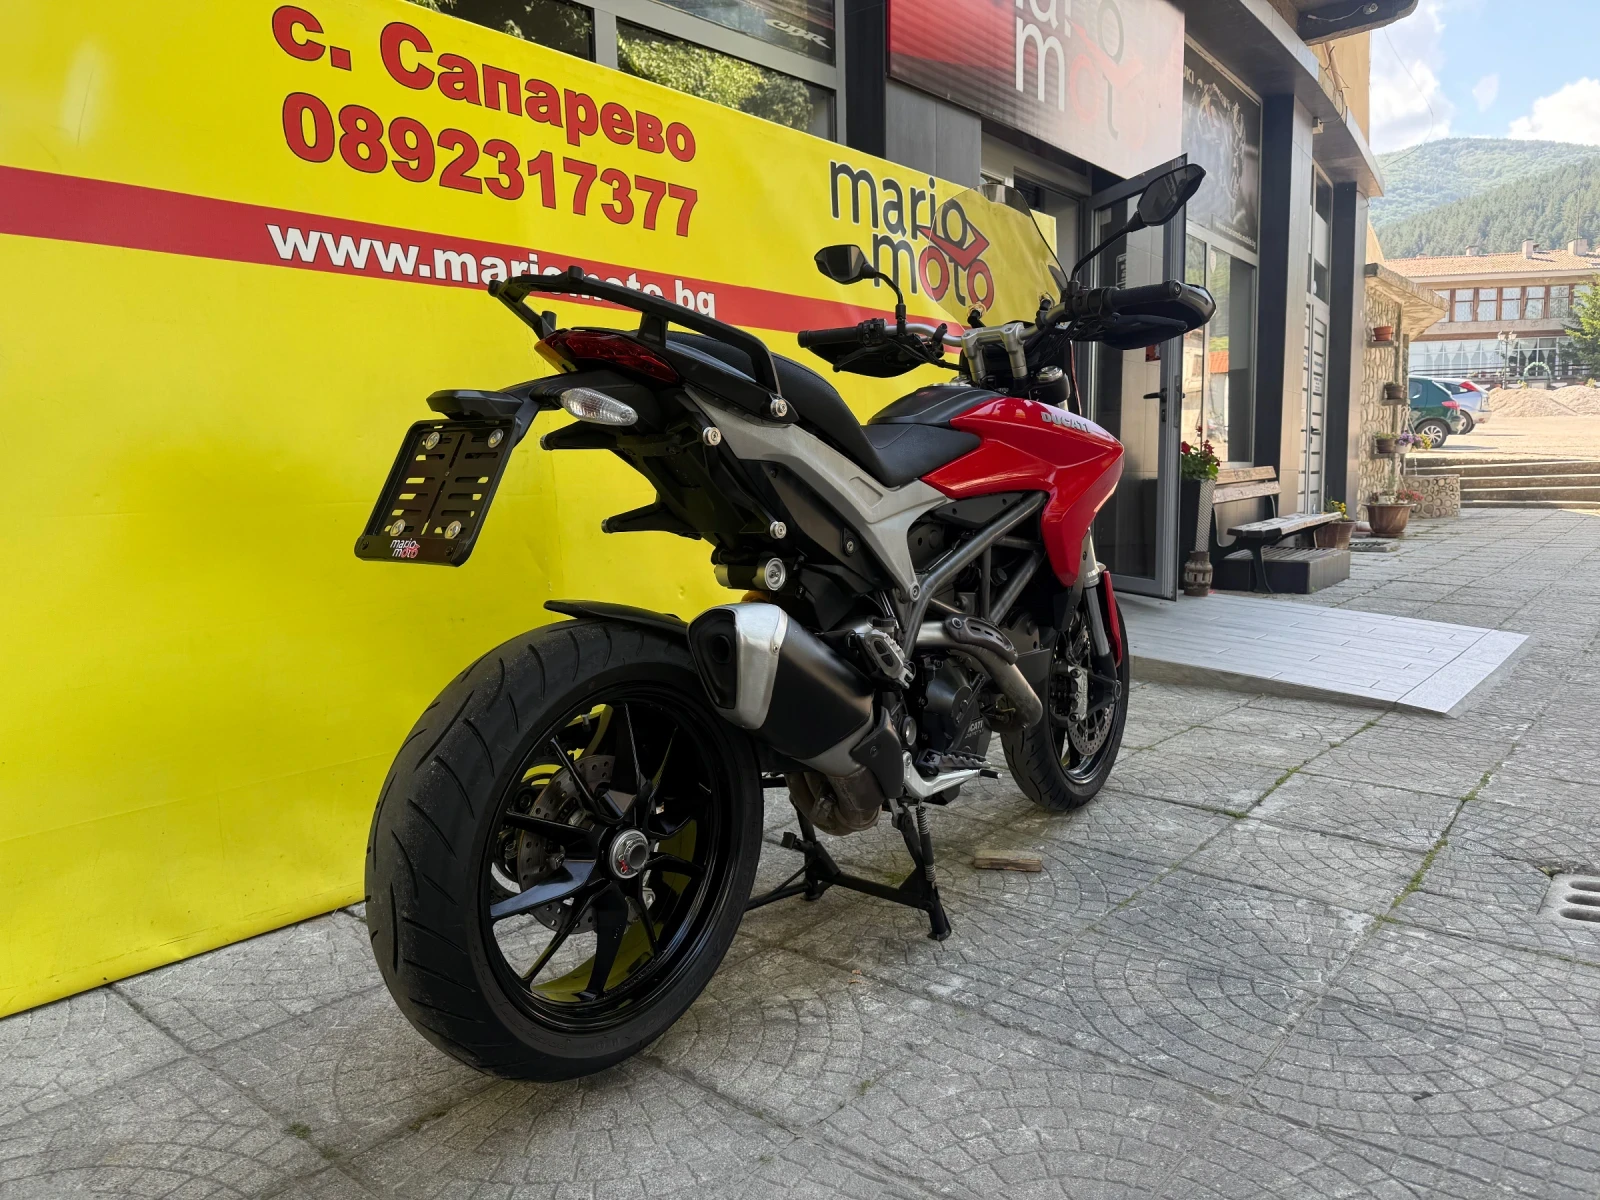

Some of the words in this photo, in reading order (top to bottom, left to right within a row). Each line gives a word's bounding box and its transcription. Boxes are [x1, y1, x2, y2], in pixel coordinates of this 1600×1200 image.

[272, 5, 352, 72] с.
[379, 21, 697, 163] Сапарево
[282, 91, 698, 238] 0892317377
[829, 161, 968, 250] mario
[872, 233, 994, 312] moto
[1040, 411, 1090, 434] DUCATI
[390, 538, 418, 549] mario
[391, 548, 419, 559] moto
